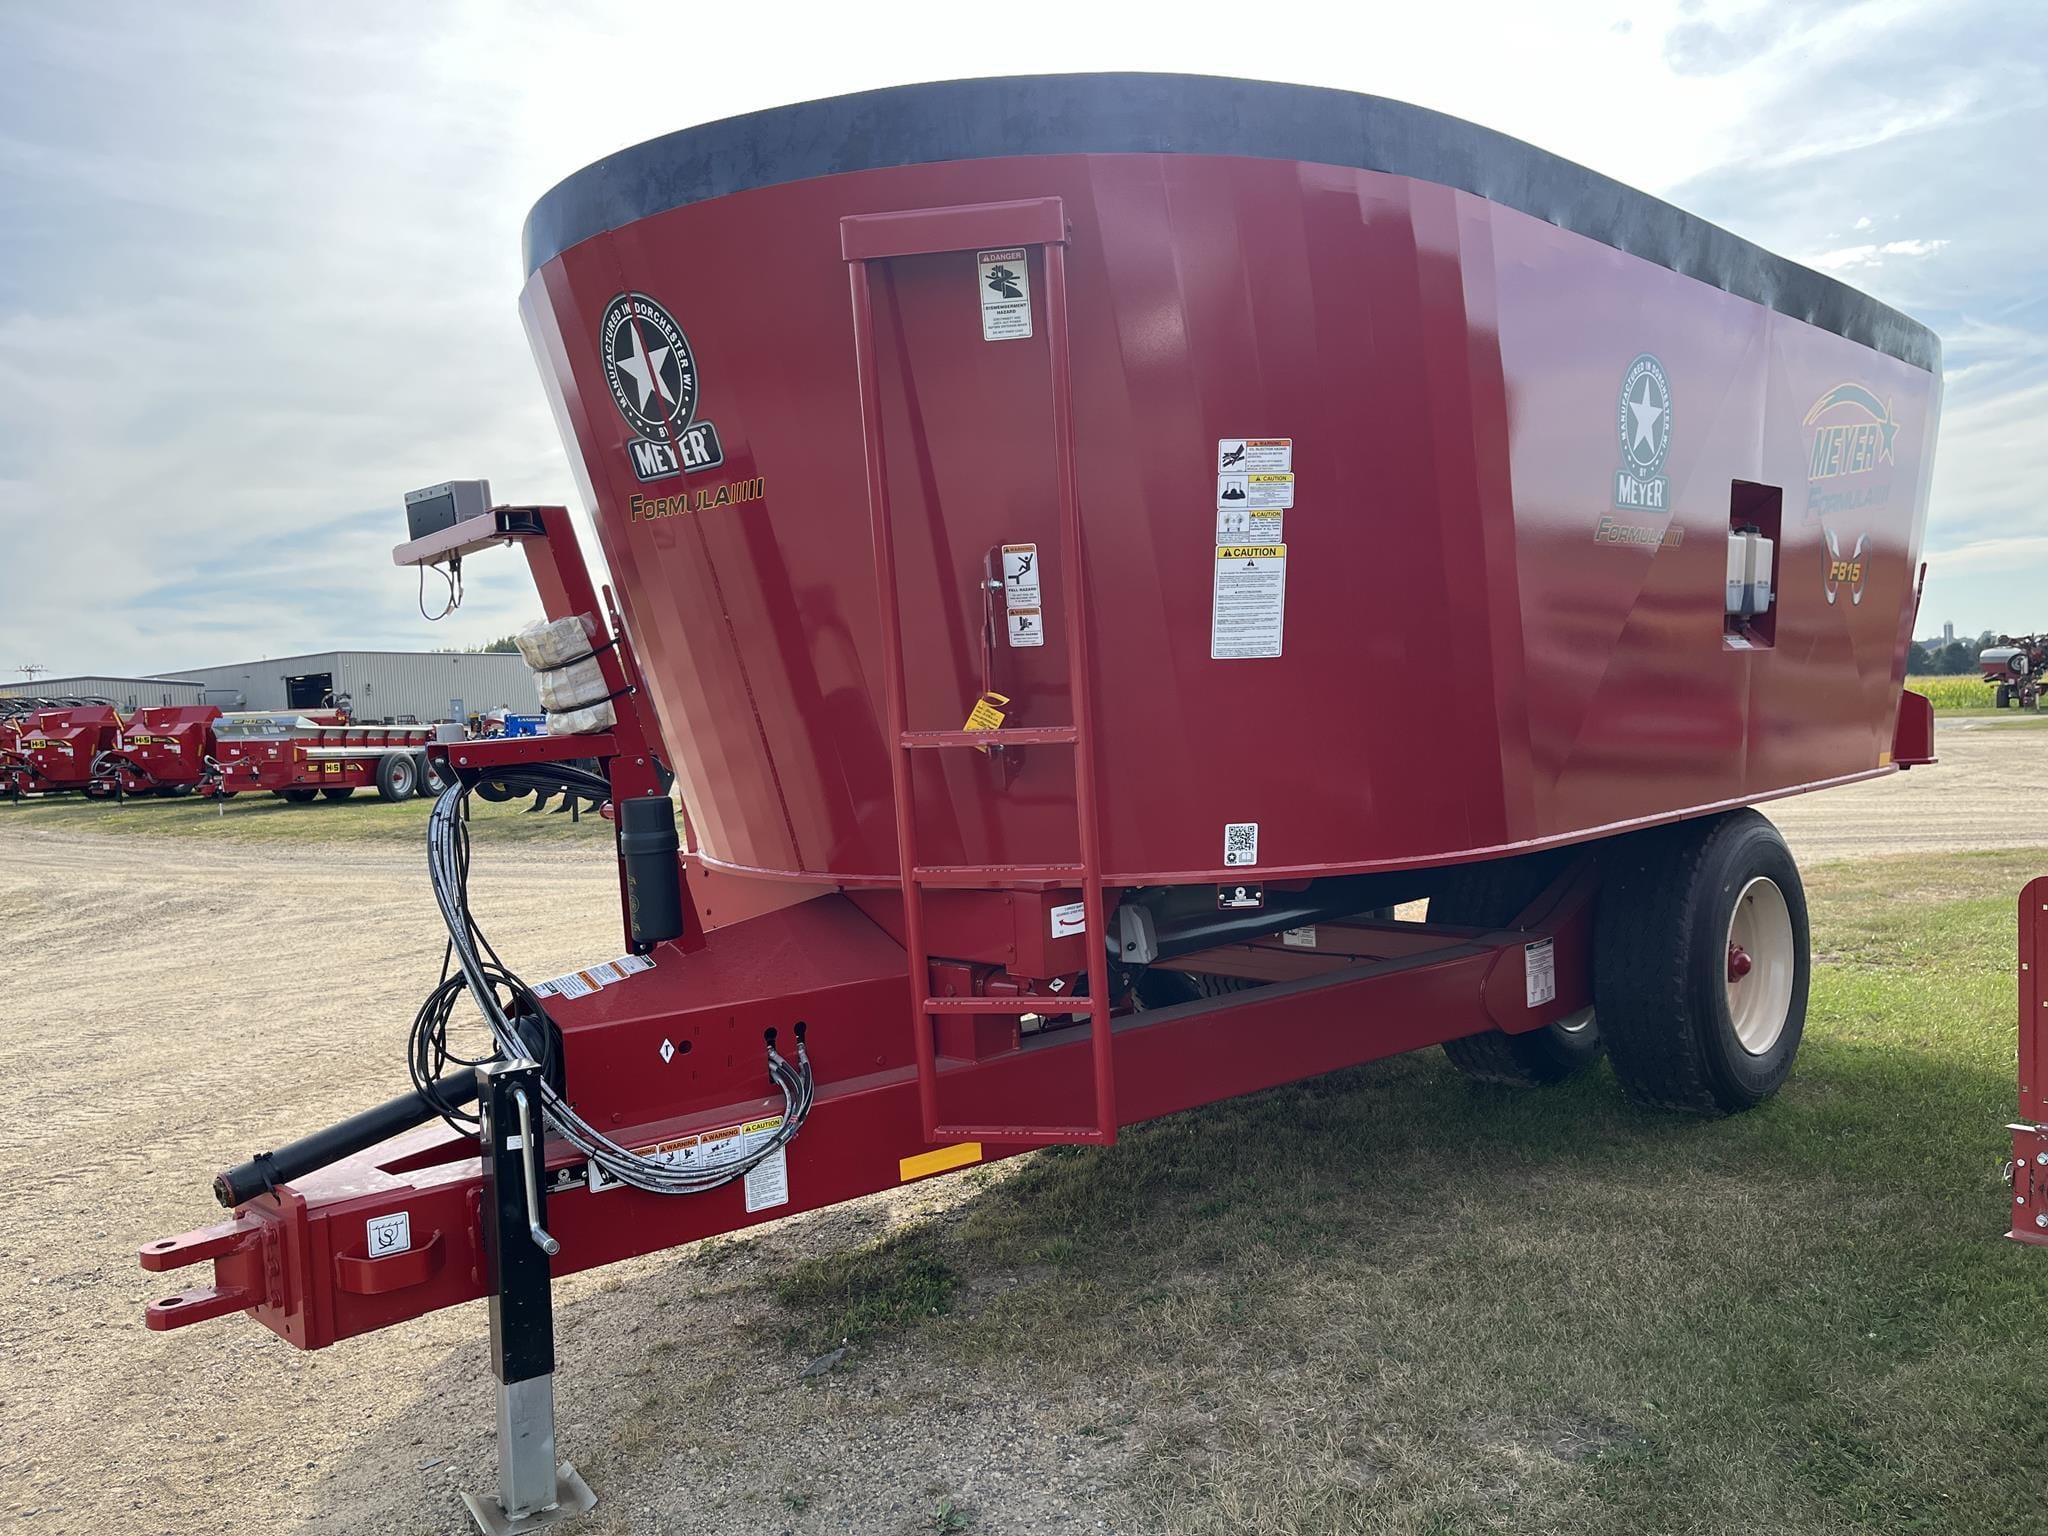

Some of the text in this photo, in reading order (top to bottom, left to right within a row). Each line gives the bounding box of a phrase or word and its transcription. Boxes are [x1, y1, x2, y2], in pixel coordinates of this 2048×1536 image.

[990, 251, 1021, 261] DANGER
[605, 301, 693, 409] MANUFACTURED IN DORCHESTER WI
[1620, 361, 1645, 441] MANUFACTURED
[1645, 361, 1651, 371] IN
[1652, 362, 1670, 430] DORCHESTER
[634, 431, 712, 476] MEYER
[1808, 424, 1879, 481] MEYER
[1619, 475, 1663, 508] MEYER
[1233, 548, 1277, 557] CAUTION
[1829, 561, 1860, 583] F815
[708, 1129, 739, 1141] WARNING
[751, 1119, 780, 1132] CAUTION
[667, 1139, 698, 1151] WARNING
